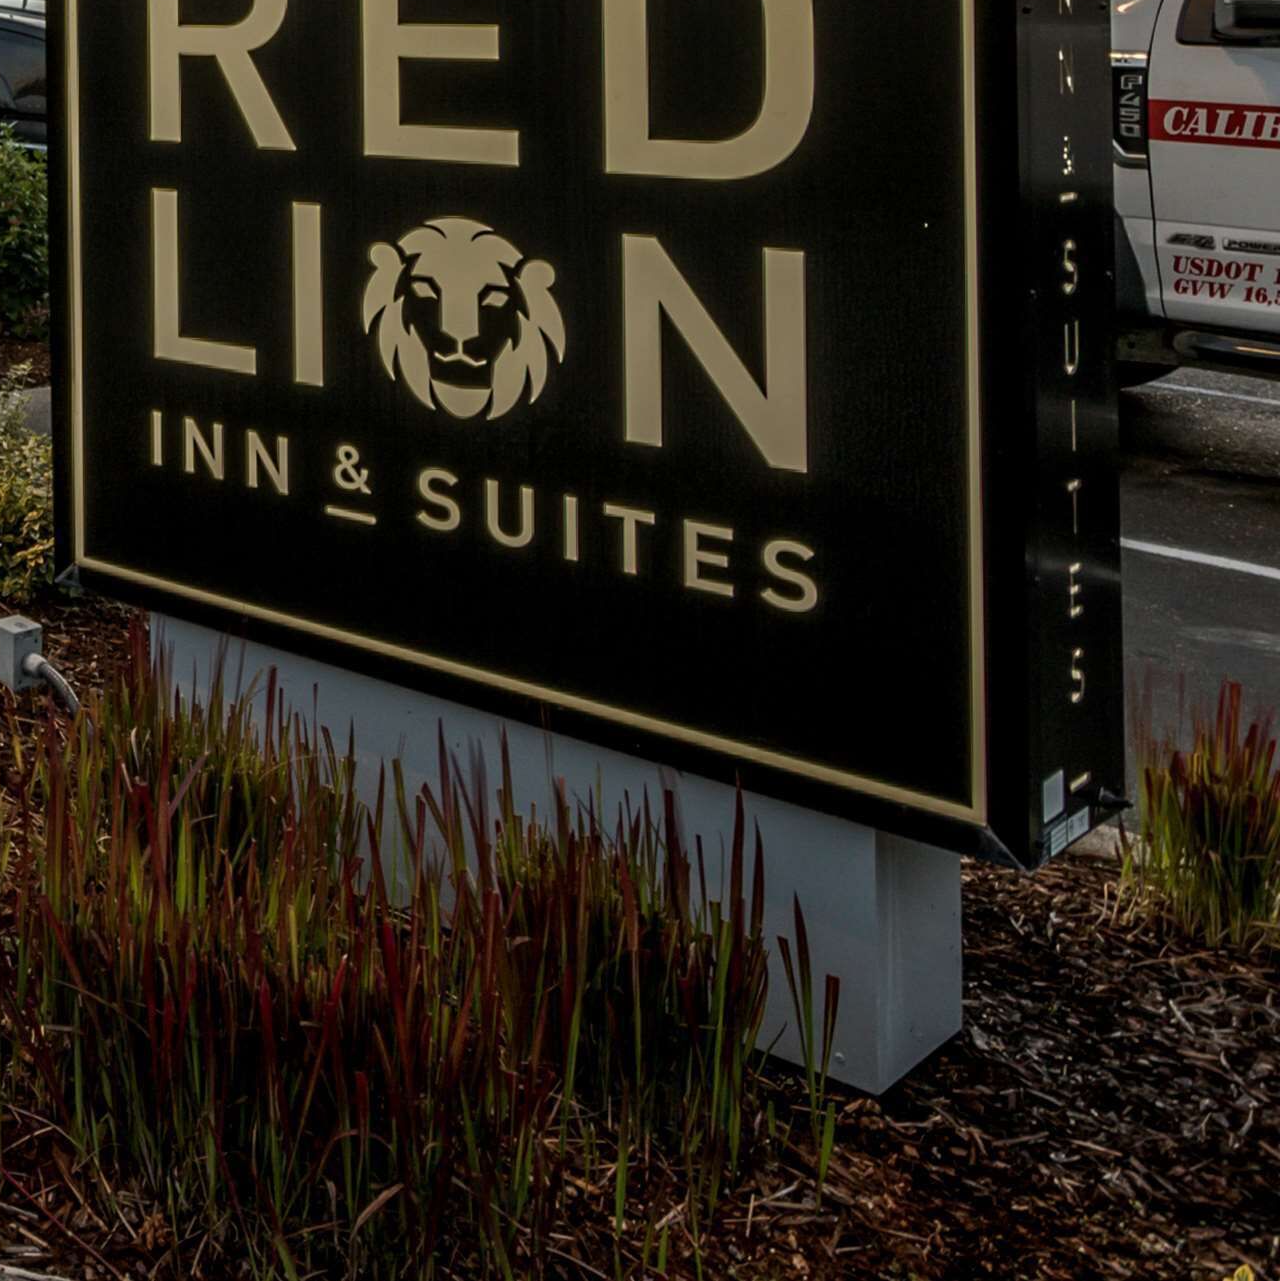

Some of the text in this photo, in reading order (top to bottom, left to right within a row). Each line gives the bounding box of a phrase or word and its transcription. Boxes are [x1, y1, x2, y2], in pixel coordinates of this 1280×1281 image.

[1173, 255, 1264, 283] USDOT
[1173, 278, 1235, 300] GVW
[151, 409, 818, 613] INN & SUITES
